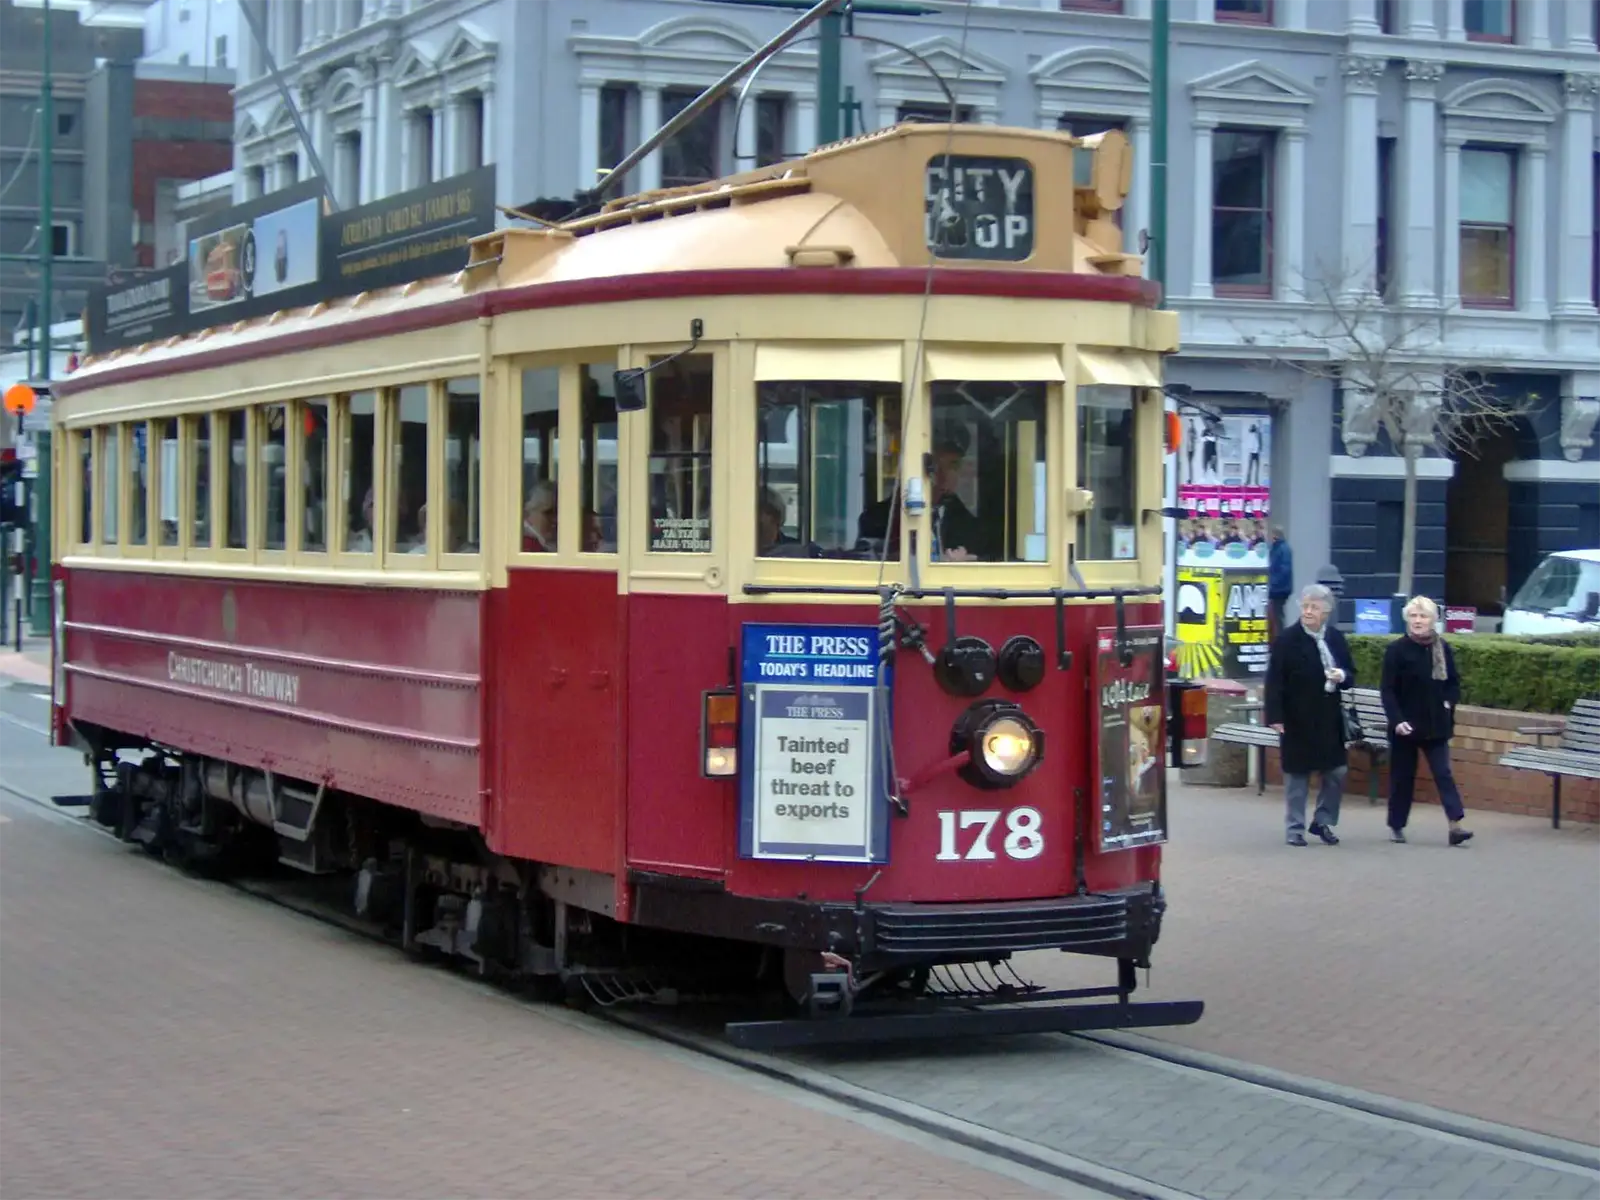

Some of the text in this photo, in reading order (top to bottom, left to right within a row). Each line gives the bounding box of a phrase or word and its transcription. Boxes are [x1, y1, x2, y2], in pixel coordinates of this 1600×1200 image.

[926, 167, 1026, 215] CITY
[925, 213, 1028, 249] LOP
[766, 635, 869, 656] THE PRESS
[168, 651, 298, 705] CHRISTCHURCH TRAMWAY
[759, 662, 875, 678] TODAY'S HEADLINE
[785, 706, 844, 719] THE PRESS
[777, 736, 849, 754] Tainted
[791, 758, 836, 774] beef
[771, 779, 854, 797] threat to
[775, 802, 849, 820] exports
[935, 806, 1044, 860] 178
